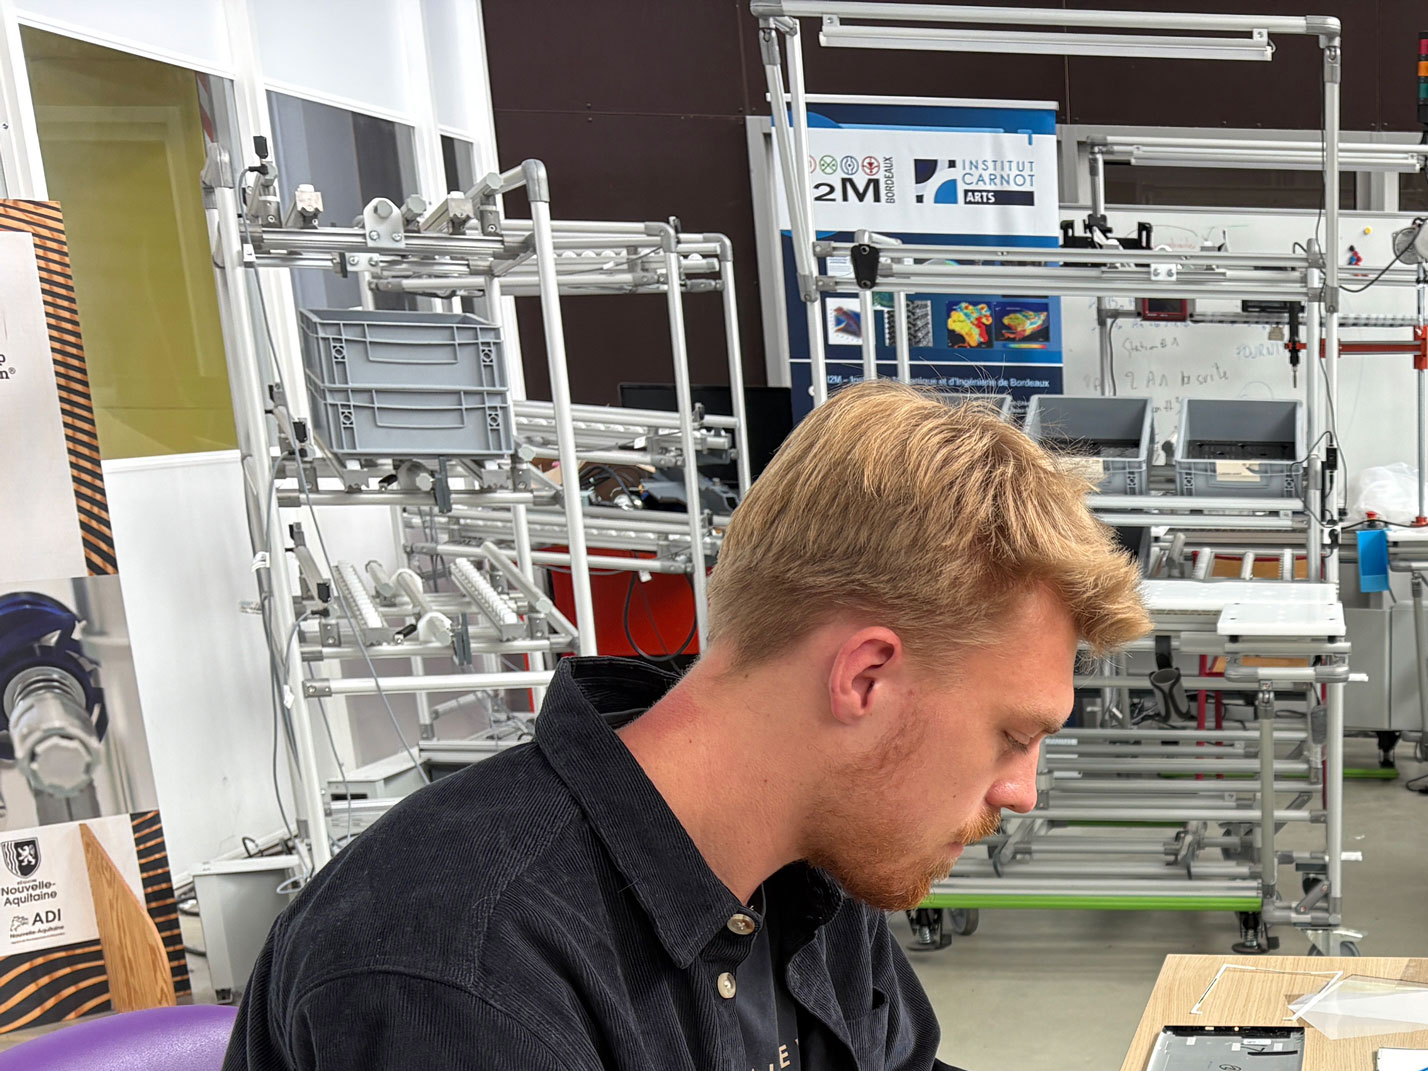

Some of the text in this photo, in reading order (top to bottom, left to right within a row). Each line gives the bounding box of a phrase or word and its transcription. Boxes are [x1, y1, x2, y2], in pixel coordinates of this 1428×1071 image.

[962, 159, 1035, 172] INSTITUT
[885, 157, 895, 204] BORDEAUX
[962, 172, 1035, 187] CARNOT
[813, 177, 881, 203] 2M
[966, 191, 995, 203] ARTS
[998, 378, 1008, 386] de
[1010, 378, 1050, 387] Bordeaux
[1, 881, 56, 896] Nouvelle-
[4, 891, 57, 907] Aquitaine
[32, 908, 61, 926] ADI
